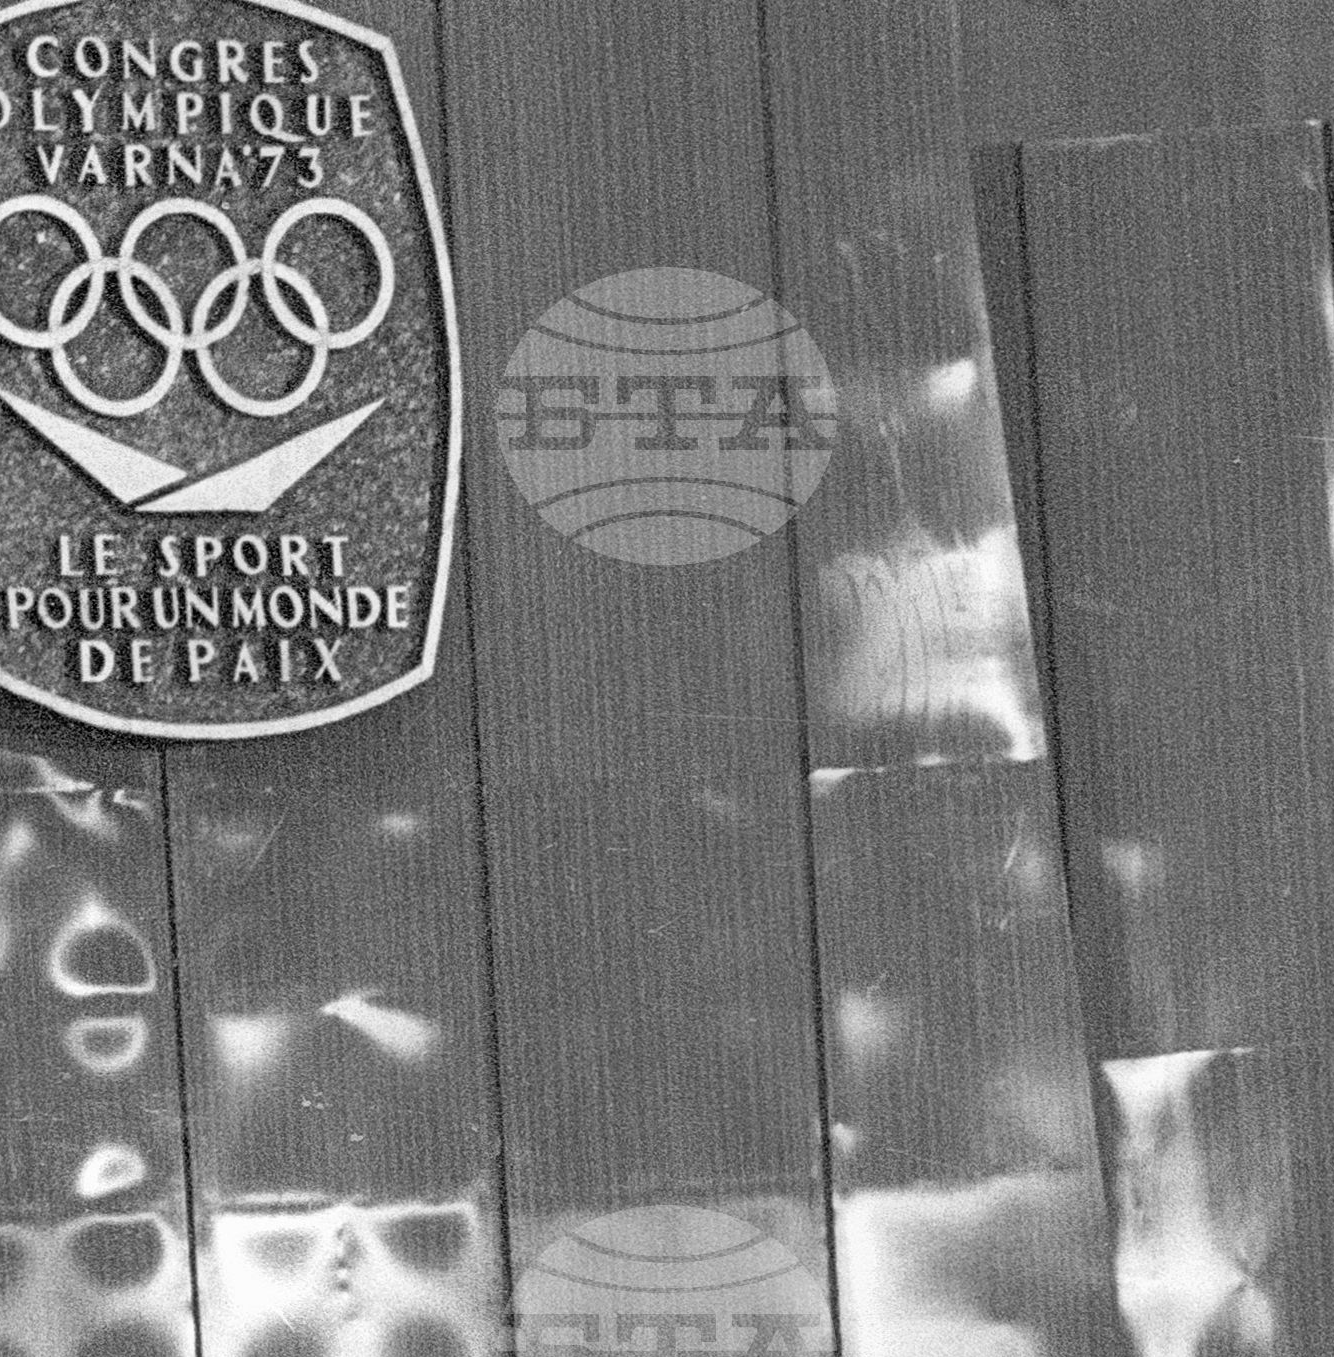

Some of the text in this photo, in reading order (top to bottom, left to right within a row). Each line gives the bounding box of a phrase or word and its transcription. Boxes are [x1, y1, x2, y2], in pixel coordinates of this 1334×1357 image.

[27, 35, 320, 84] CONGRES
[59, 534, 349, 577] LE SPORT
[7, 587, 410, 631] POUR UN MONDE
[79, 638, 343, 684] DE PAIX
